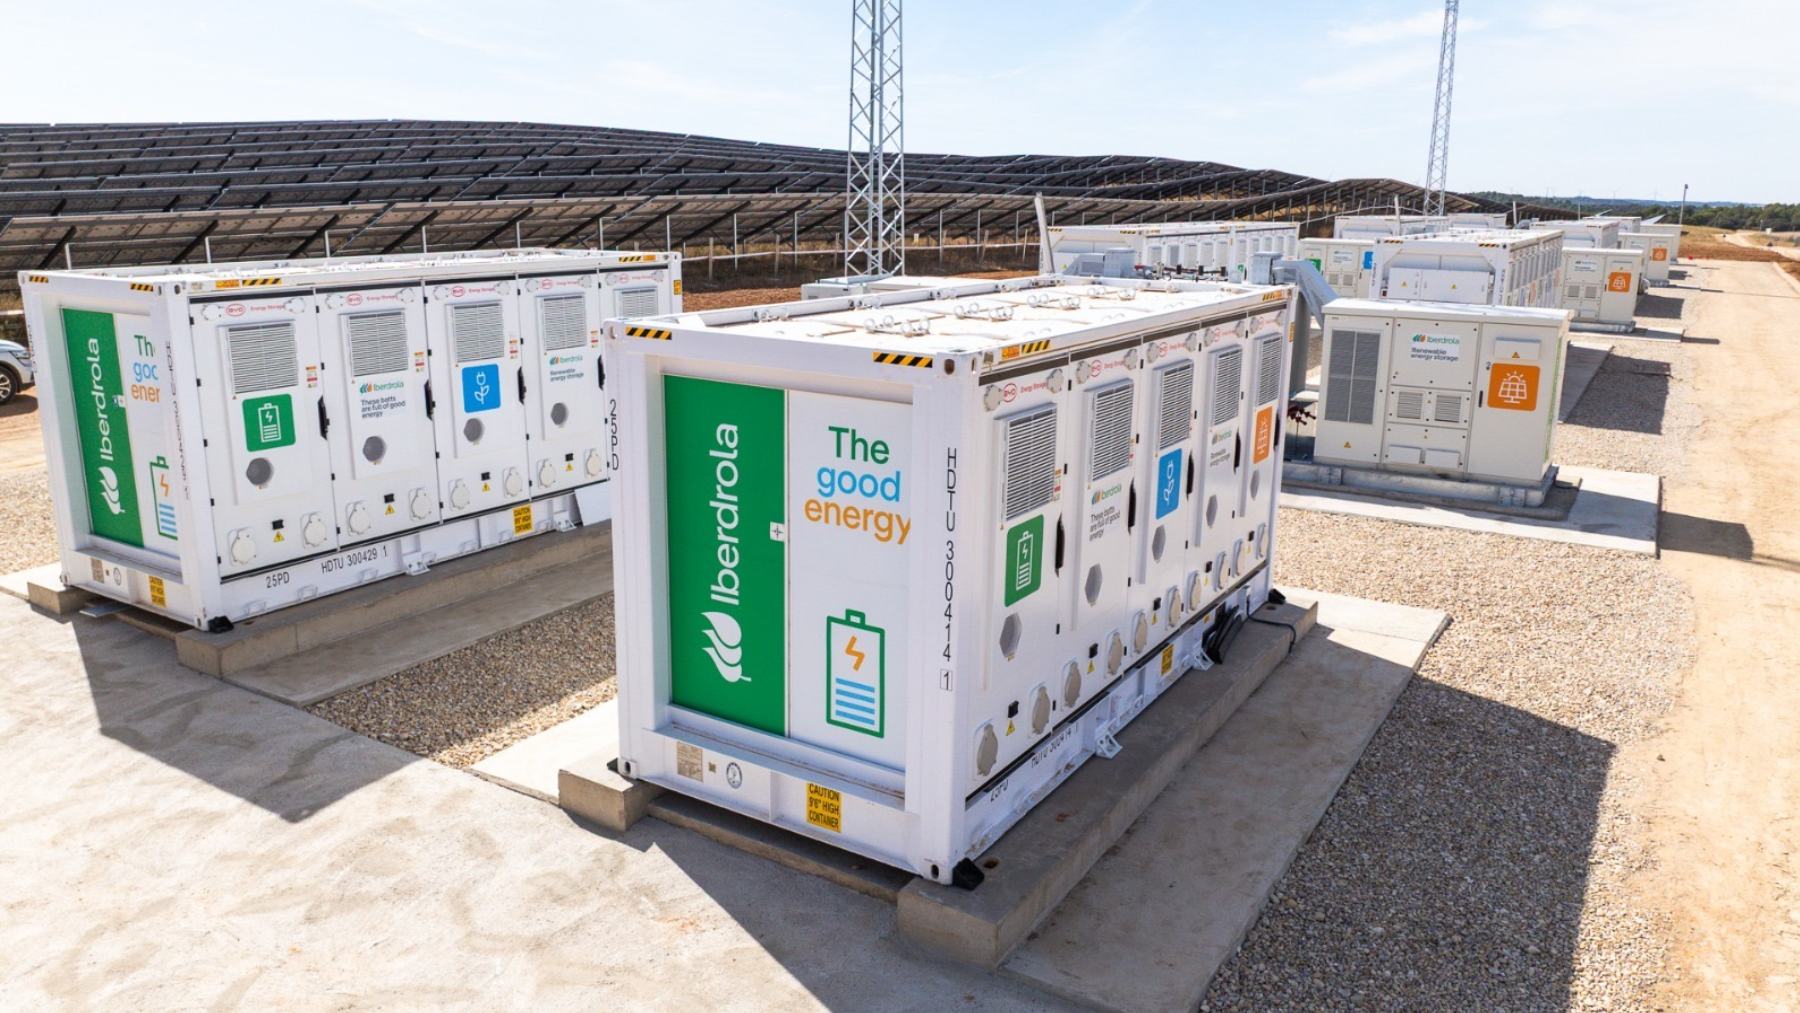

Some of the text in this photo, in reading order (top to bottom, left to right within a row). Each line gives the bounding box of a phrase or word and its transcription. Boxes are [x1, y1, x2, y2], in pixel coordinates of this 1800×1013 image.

[134, 334, 156, 357] Th
[1426, 336, 1460, 344] Iberdrola
[86, 338, 114, 461] Iberdrola
[610, 398, 620, 470] 25PD
[828, 426, 890, 464] The
[817, 466, 902, 502] good
[946, 447, 957, 532] HDTU
[709, 423, 740, 606] Iberdrola
[804, 498, 911, 545] energy
[321, 558, 344, 574] HDTU
[348, 548, 378, 566] 300429
[266, 572, 290, 588] 25PD
[942, 540, 954, 662] 300414
[809, 784, 840, 800] CAUTION
[822, 800, 840, 816] HIGH
[809, 810, 840, 830] CONTAINER
